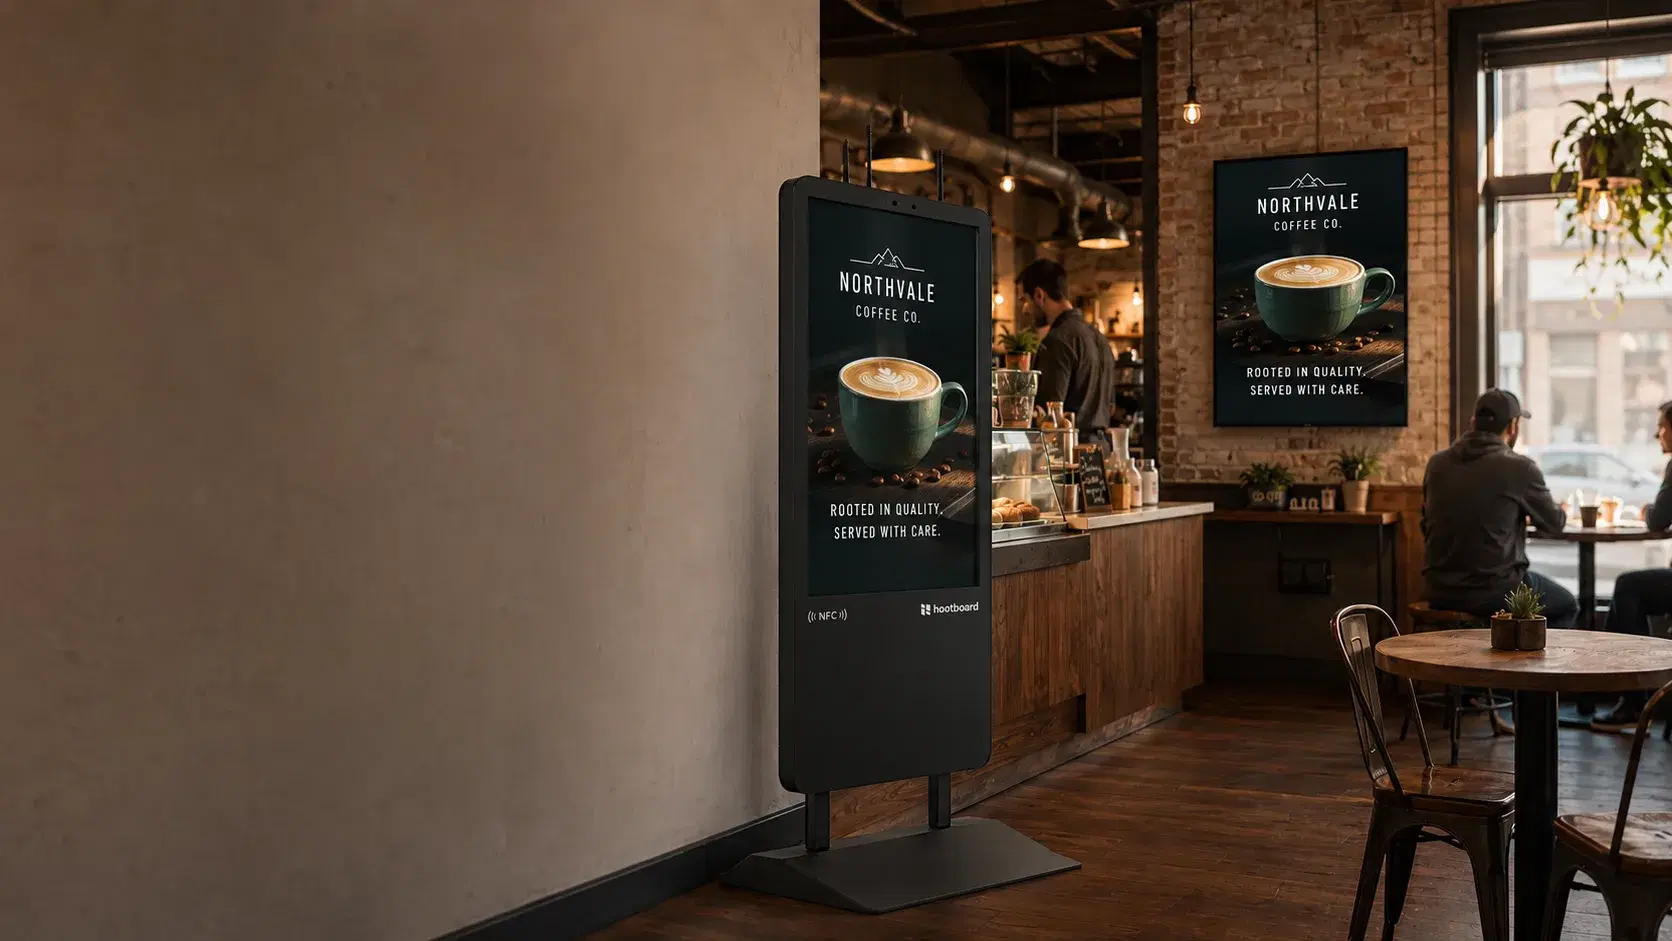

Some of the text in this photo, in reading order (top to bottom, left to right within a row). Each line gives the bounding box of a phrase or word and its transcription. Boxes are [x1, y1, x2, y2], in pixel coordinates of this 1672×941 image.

[1257, 193, 1359, 215] NORTHVALE
[1273, 218, 1342, 232] COFFEE CO.
[840, 271, 935, 303] NORTHVALE
[855, 304, 921, 324] COFFEE CO.
[1246, 366, 1291, 378] ROOTED
[1296, 366, 1308, 378] IN
[1250, 383, 1364, 396] SERVED WITH CARE.
[830, 503, 875, 517] ROOTED
[879, 503, 891, 516] IN
[834, 524, 941, 540] SERVED WITH CARE.
[933, 601, 979, 614] hootboard
[818, 610, 838, 621] NFC
